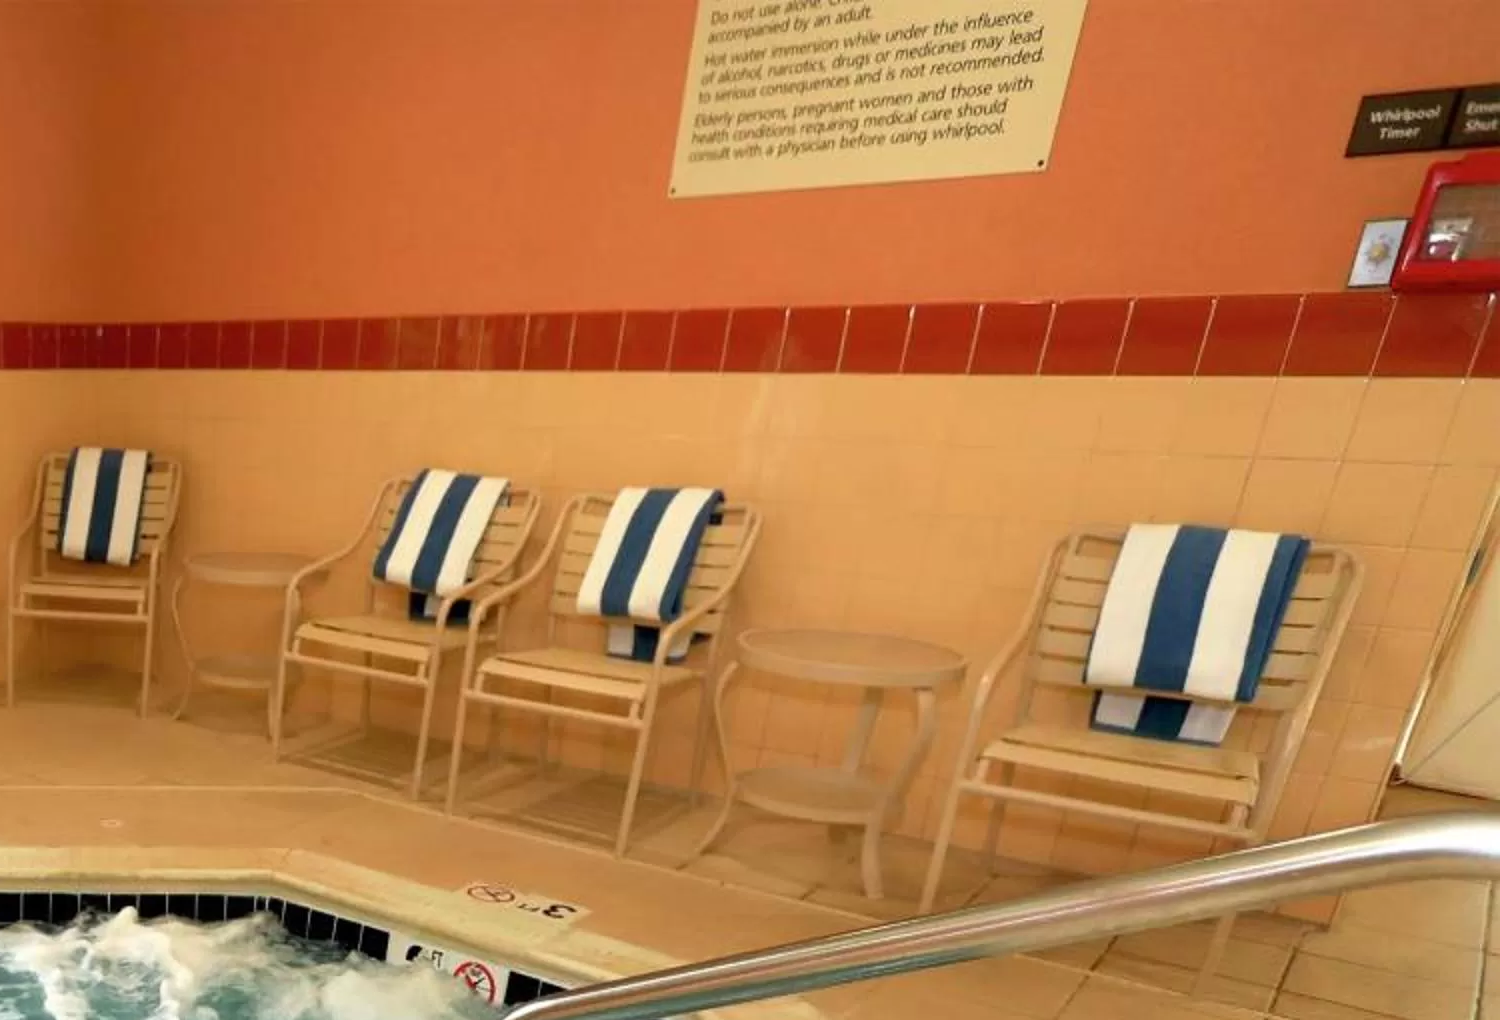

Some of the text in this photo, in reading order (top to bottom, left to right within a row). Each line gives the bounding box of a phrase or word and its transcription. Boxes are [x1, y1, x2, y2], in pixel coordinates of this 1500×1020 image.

[704, 9, 1034, 66] Hot water immersion while under the influence
[707, 18, 790, 44] accompanied
[793, 16, 810, 32] by
[814, 15, 830, 28] an
[711, 10, 728, 25] Do
[732, 7, 755, 21] not
[759, 4, 780, 17] use
[698, 47, 1045, 105] to serious consequences and is not recommended.
[701, 71, 715, 86] of
[831, 53, 870, 70] drugs
[875, 51, 890, 64] or
[894, 41, 966, 61] medicines
[971, 35, 1004, 51] may
[1009, 25, 1045, 45] lead
[691, 98, 1009, 145] health conditions requiring medical care should
[694, 112, 733, 128] Elderly
[792, 98, 855, 119] pregnant
[858, 93, 913, 110] women
[917, 86, 947, 103] and
[951, 82, 993, 100] those
[997, 74, 1034, 93] with
[1370, 104, 1443, 124] Whirlpool
[688, 118, 1005, 163] consult with a physician before using whirlpool.
[1380, 127, 1421, 139] Timer
